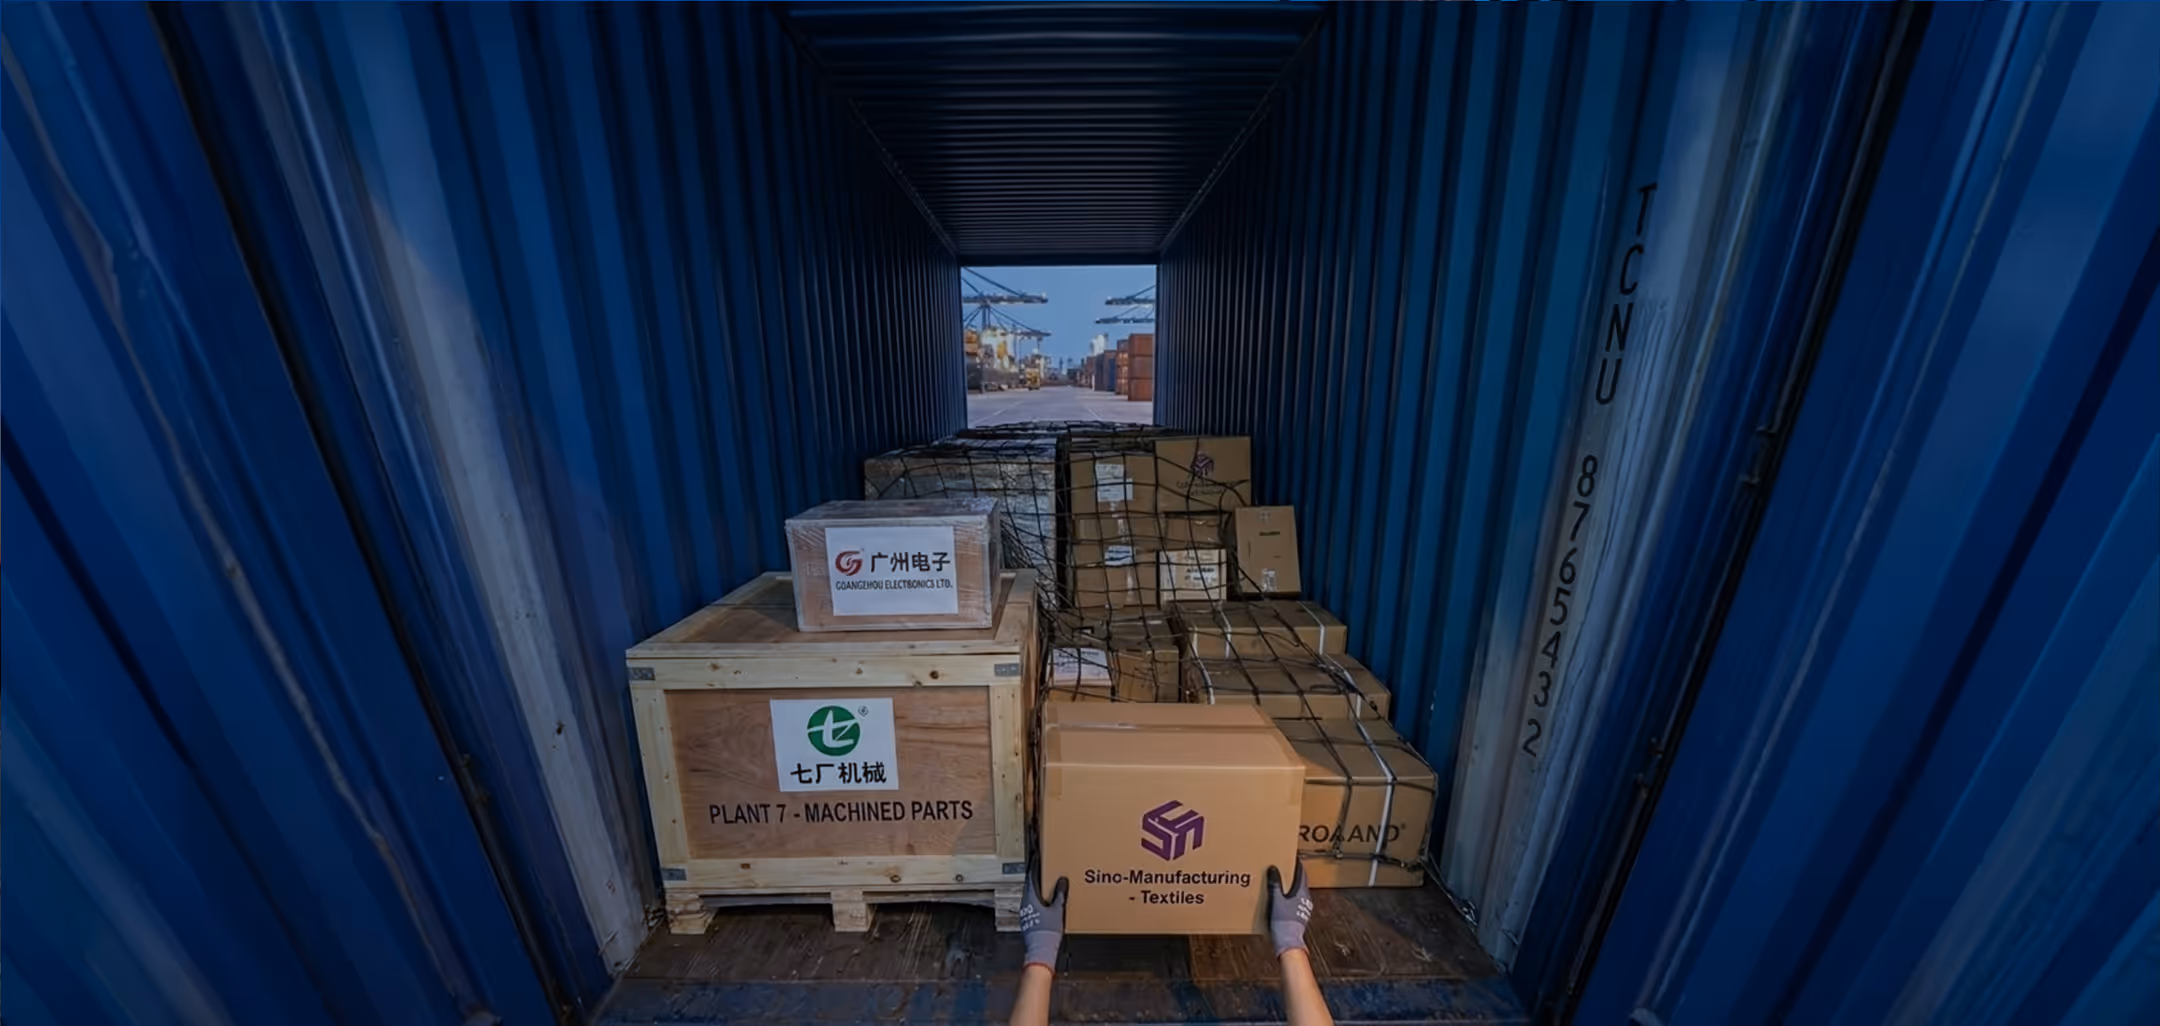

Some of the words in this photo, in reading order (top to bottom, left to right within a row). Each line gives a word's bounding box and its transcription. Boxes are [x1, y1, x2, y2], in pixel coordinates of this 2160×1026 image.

[1595, 183, 1657, 405] TCNU
[870, 551, 951, 573] 广州电子
[1521, 455, 1598, 758] 8765432
[790, 762, 887, 784] 七厂机械
[709, 803, 770, 824] PLANT
[776, 803, 787, 823] 7
[804, 802, 905, 823] MACHINED
[911, 800, 973, 821] PARTS
[1084, 869, 1251, 888] Sino-Manufacturing
[1141, 889, 1205, 904] Textiles
